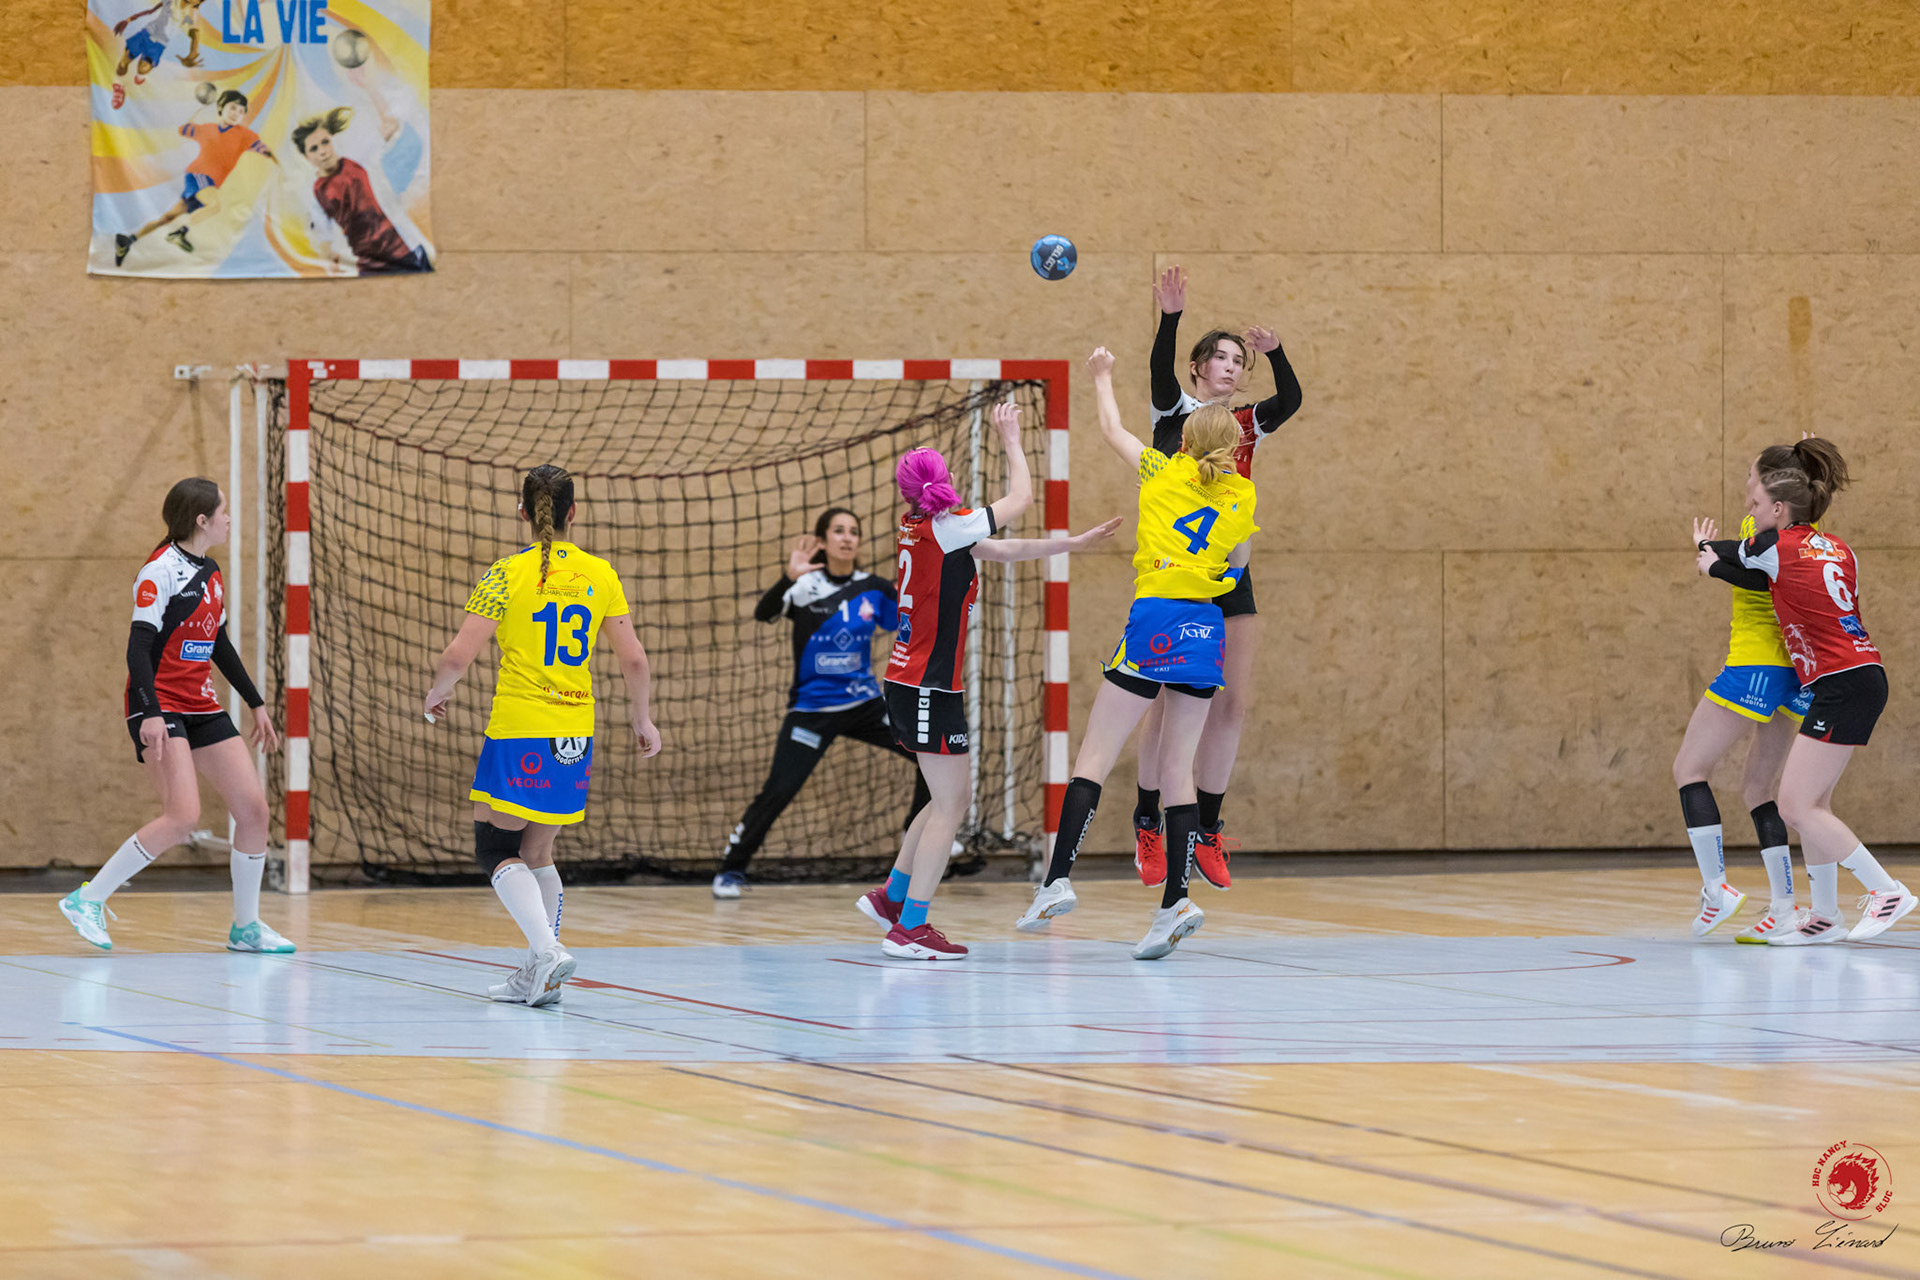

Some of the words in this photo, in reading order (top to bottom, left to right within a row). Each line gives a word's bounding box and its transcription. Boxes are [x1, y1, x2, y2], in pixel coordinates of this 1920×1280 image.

[222, 0, 264, 43] LA
[275, 0, 328, 43] VIE
[1172, 505, 1220, 555] 4
[201, 581, 211, 604] 3
[1822, 562, 1854, 612] 6
[838, 599, 849, 622] 1
[532, 601, 593, 667] 13
[1136, 655, 1187, 667] VEOLIA
[507, 777, 551, 788] VEOLIA
[1069, 808, 1096, 862] Kempa
[1180, 831, 1197, 889] Kempa
[1783, 856, 1794, 894] Kempa
